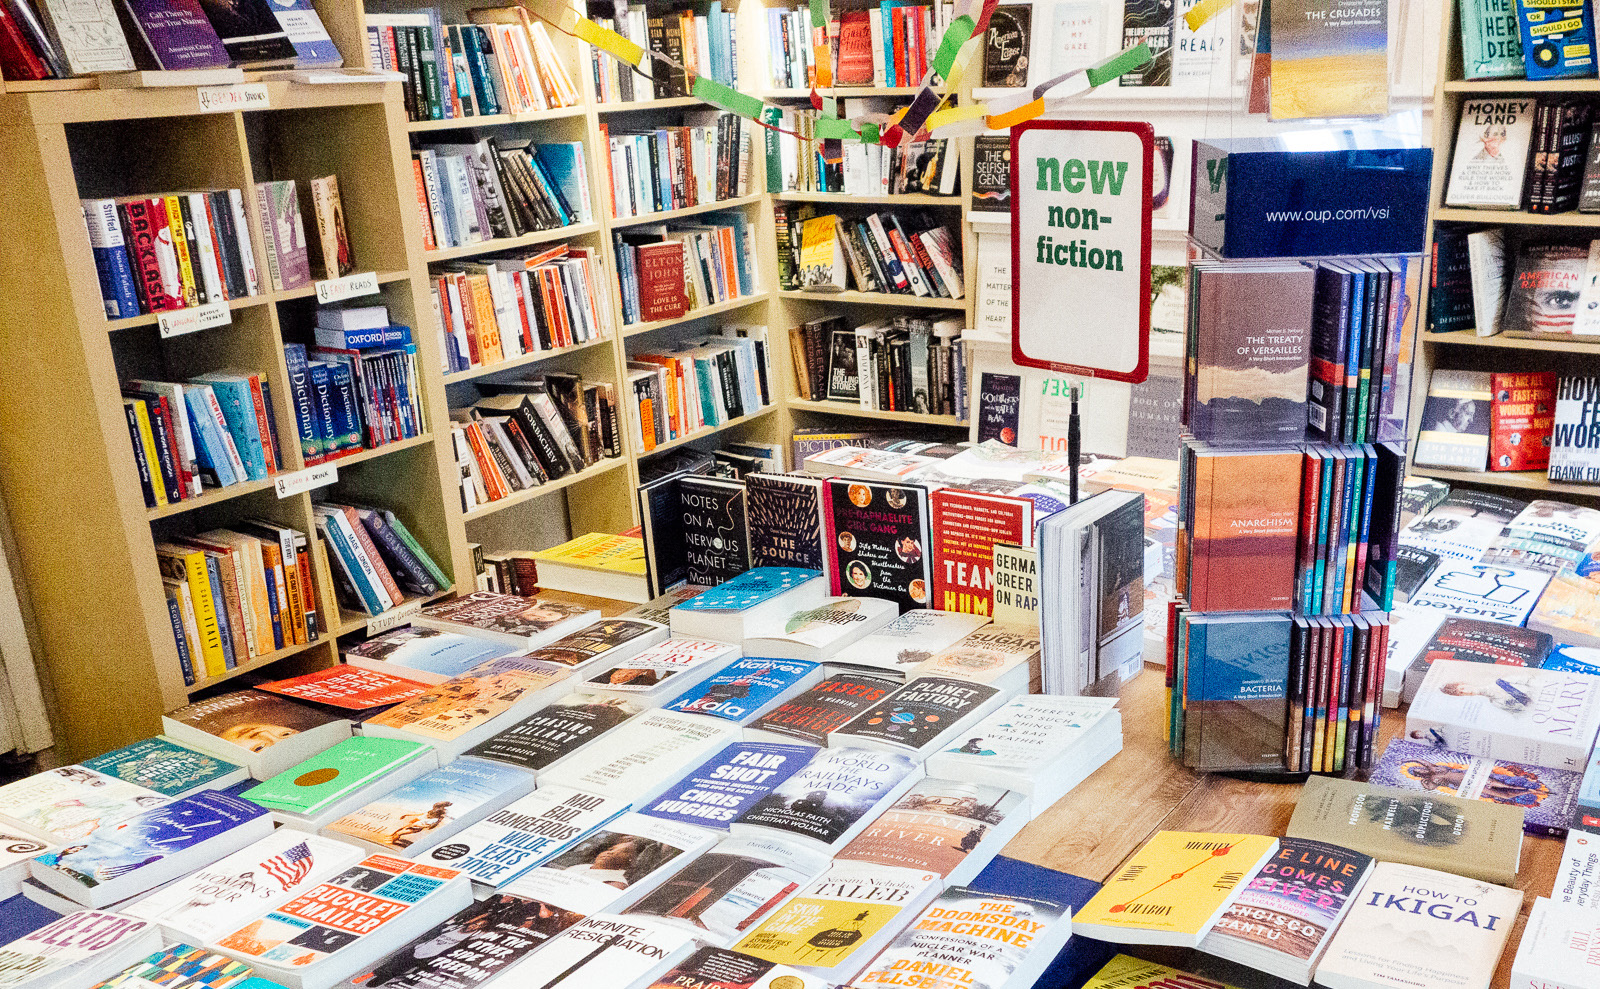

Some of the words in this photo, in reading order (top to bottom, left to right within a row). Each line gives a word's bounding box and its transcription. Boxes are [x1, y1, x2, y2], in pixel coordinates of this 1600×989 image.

[1305, 11, 1326, 20] THE
[1328, 7, 1382, 19] CRUSADES
[1532, 24, 1562, 35] SHOULD
[1567, 20, 1580, 28] GO
[1180, 37, 1225, 52] REAL?
[1468, 102, 1529, 115] MONEY
[1474, 115, 1517, 125] LAND
[984, 150, 1002, 162] THE
[976, 162, 1010, 174] SELFISH
[1036, 157, 1128, 196] new
[423, 157, 434, 183] NEW
[430, 185, 441, 218] NOISE
[978, 174, 1007, 185] GENE
[103, 203, 117, 232] Stiffed
[1047, 204, 1113, 232] non-
[1266, 206, 1390, 223] www.oup.com/vsi
[645, 256, 683, 267] ELTON
[1036, 236, 1124, 272] fiction
[650, 268, 679, 280] JOHN
[1518, 271, 1579, 281] AMERICAN
[350, 280, 372, 291] READS
[986, 283, 1012, 291] MATTER
[1520, 280, 1572, 289] RADICAL
[664, 302, 682, 311] CURE
[997, 299, 1009, 307] THE
[348, 333, 383, 344] OXFORD
[1246, 336, 1265, 344] THE
[1268, 335, 1303, 344] TREATY
[1237, 347, 1249, 355] OF
[1252, 346, 1302, 355] VERSAILLES
[832, 375, 859, 384] ROLLING
[833, 367, 846, 375] THE
[832, 382, 857, 391] STONES
[293, 372, 313, 442] Dictionary
[317, 385, 335, 440] Dictionary
[340, 386, 354, 430] Dictionary
[1500, 403, 1535, 416] WORKERS
[523, 406, 558, 464] GORBACHEV
[1550, 465, 1584, 480] FRANK
[681, 493, 719, 511] NOTES
[683, 512, 702, 527] ON
[706, 517, 714, 529] A
[869, 522, 898, 535] GANG
[1230, 518, 1293, 528] ANARCHISM
[685, 532, 739, 552] NERVOUS
[773, 536, 796, 550] THE
[347, 533, 360, 551] MADE
[358, 553, 373, 575] LONDON
[687, 552, 727, 569] PLANET
[762, 546, 810, 564] SOURCE
[997, 553, 1036, 575] GERMA
[689, 570, 712, 586] Matt
[996, 571, 1033, 592] GREER
[996, 589, 1011, 605] ON
[1015, 595, 1038, 612] RAP
[1414, 599, 1518, 623] Zucked
[371, 618, 396, 632] STUDY
[969, 633, 1040, 650] SUGAR
[733, 660, 803, 675] Natives
[916, 682, 979, 698] PLANET
[1240, 684, 1283, 693] BACTERIA
[672, 697, 746, 718] Akala
[897, 690, 972, 711] FACTORY
[1549, 676, 1590, 738] MARY
[526, 716, 594, 735] CHASING
[1013, 712, 1032, 721] NO
[1036, 715, 1072, 725] SUCH
[1015, 720, 1054, 731] THING
[510, 725, 578, 744] HILLARY
[987, 732, 1045, 747] WEATHER
[1021, 729, 1048, 738] BAD
[730, 750, 787, 770] FAIR
[827, 755, 890, 773] WORLD
[855, 751, 877, 760] THE
[709, 765, 777, 784] SHOT
[838, 765, 861, 774] THE
[799, 769, 883, 791] RAILWAYS
[804, 780, 860, 795] MADE
[562, 793, 606, 813] MAD,
[679, 788, 745, 808] CHRIS
[356, 808, 391, 820] Wendy
[548, 804, 583, 825] BAD,
[652, 799, 738, 822] HUGHES
[763, 807, 804, 820] NICHOLAS
[806, 814, 832, 825] FAITH
[1348, 794, 1367, 825] PROFESSOR
[1382, 798, 1400, 830] MAXWELL'S
[338, 817, 388, 834] Mitchell
[487, 809, 581, 841] DANGEROUS
[746, 814, 789, 828] CHRISTIAN
[790, 823, 829, 836] WOLMAR
[1416, 800, 1433, 839] DUPLICITOUS
[1452, 814, 1465, 836] DEMON
[498, 830, 556, 854] WILDE,
[867, 825, 945, 847] RIVER
[1300, 848, 1357, 877] LINE
[753, 871, 772, 881] Notes
[1262, 862, 1346, 892] COMES
[1563, 869, 1579, 895] Beauty
[1572, 858, 1582, 869] of
[189, 882, 244, 903] HOUR
[305, 884, 405, 918] BUCKLEY
[815, 881, 910, 903] TALEB
[1250, 877, 1335, 910] RIVER
[1401, 884, 1450, 901] HOW
[1453, 894, 1479, 906] TO
[792, 903, 824, 914] SKIN
[979, 901, 1016, 914] THE
[1366, 890, 1501, 932] IKIGAI
[299, 903, 380, 933] MAILER
[776, 912, 794, 922] IN
[796, 914, 825, 927] THE
[927, 906, 1046, 934] DOOMSDAY
[1228, 904, 1317, 938] ANCISCO
[579, 918, 645, 937] INFINITE
[764, 923, 805, 935] GAME
[915, 919, 1037, 949] MACHINE
[1216, 917, 1284, 941] CANTÚ
[467, 940, 514, 958] OTHER
[564, 929, 670, 960] RESIGNATION
[916, 934, 977, 949] CONFESSIONS
[978, 942, 992, 950] OF
[1569, 930, 1592, 952] BILL
[446, 949, 481, 963] SIDE
[482, 957, 504, 968] OF
[910, 940, 966, 955] NUCLEAR
[968, 950, 996, 961] WAR
[916, 950, 972, 966] PLANNER
[429, 956, 491, 980] FREEDOM
[890, 958, 975, 984] DANIEL
